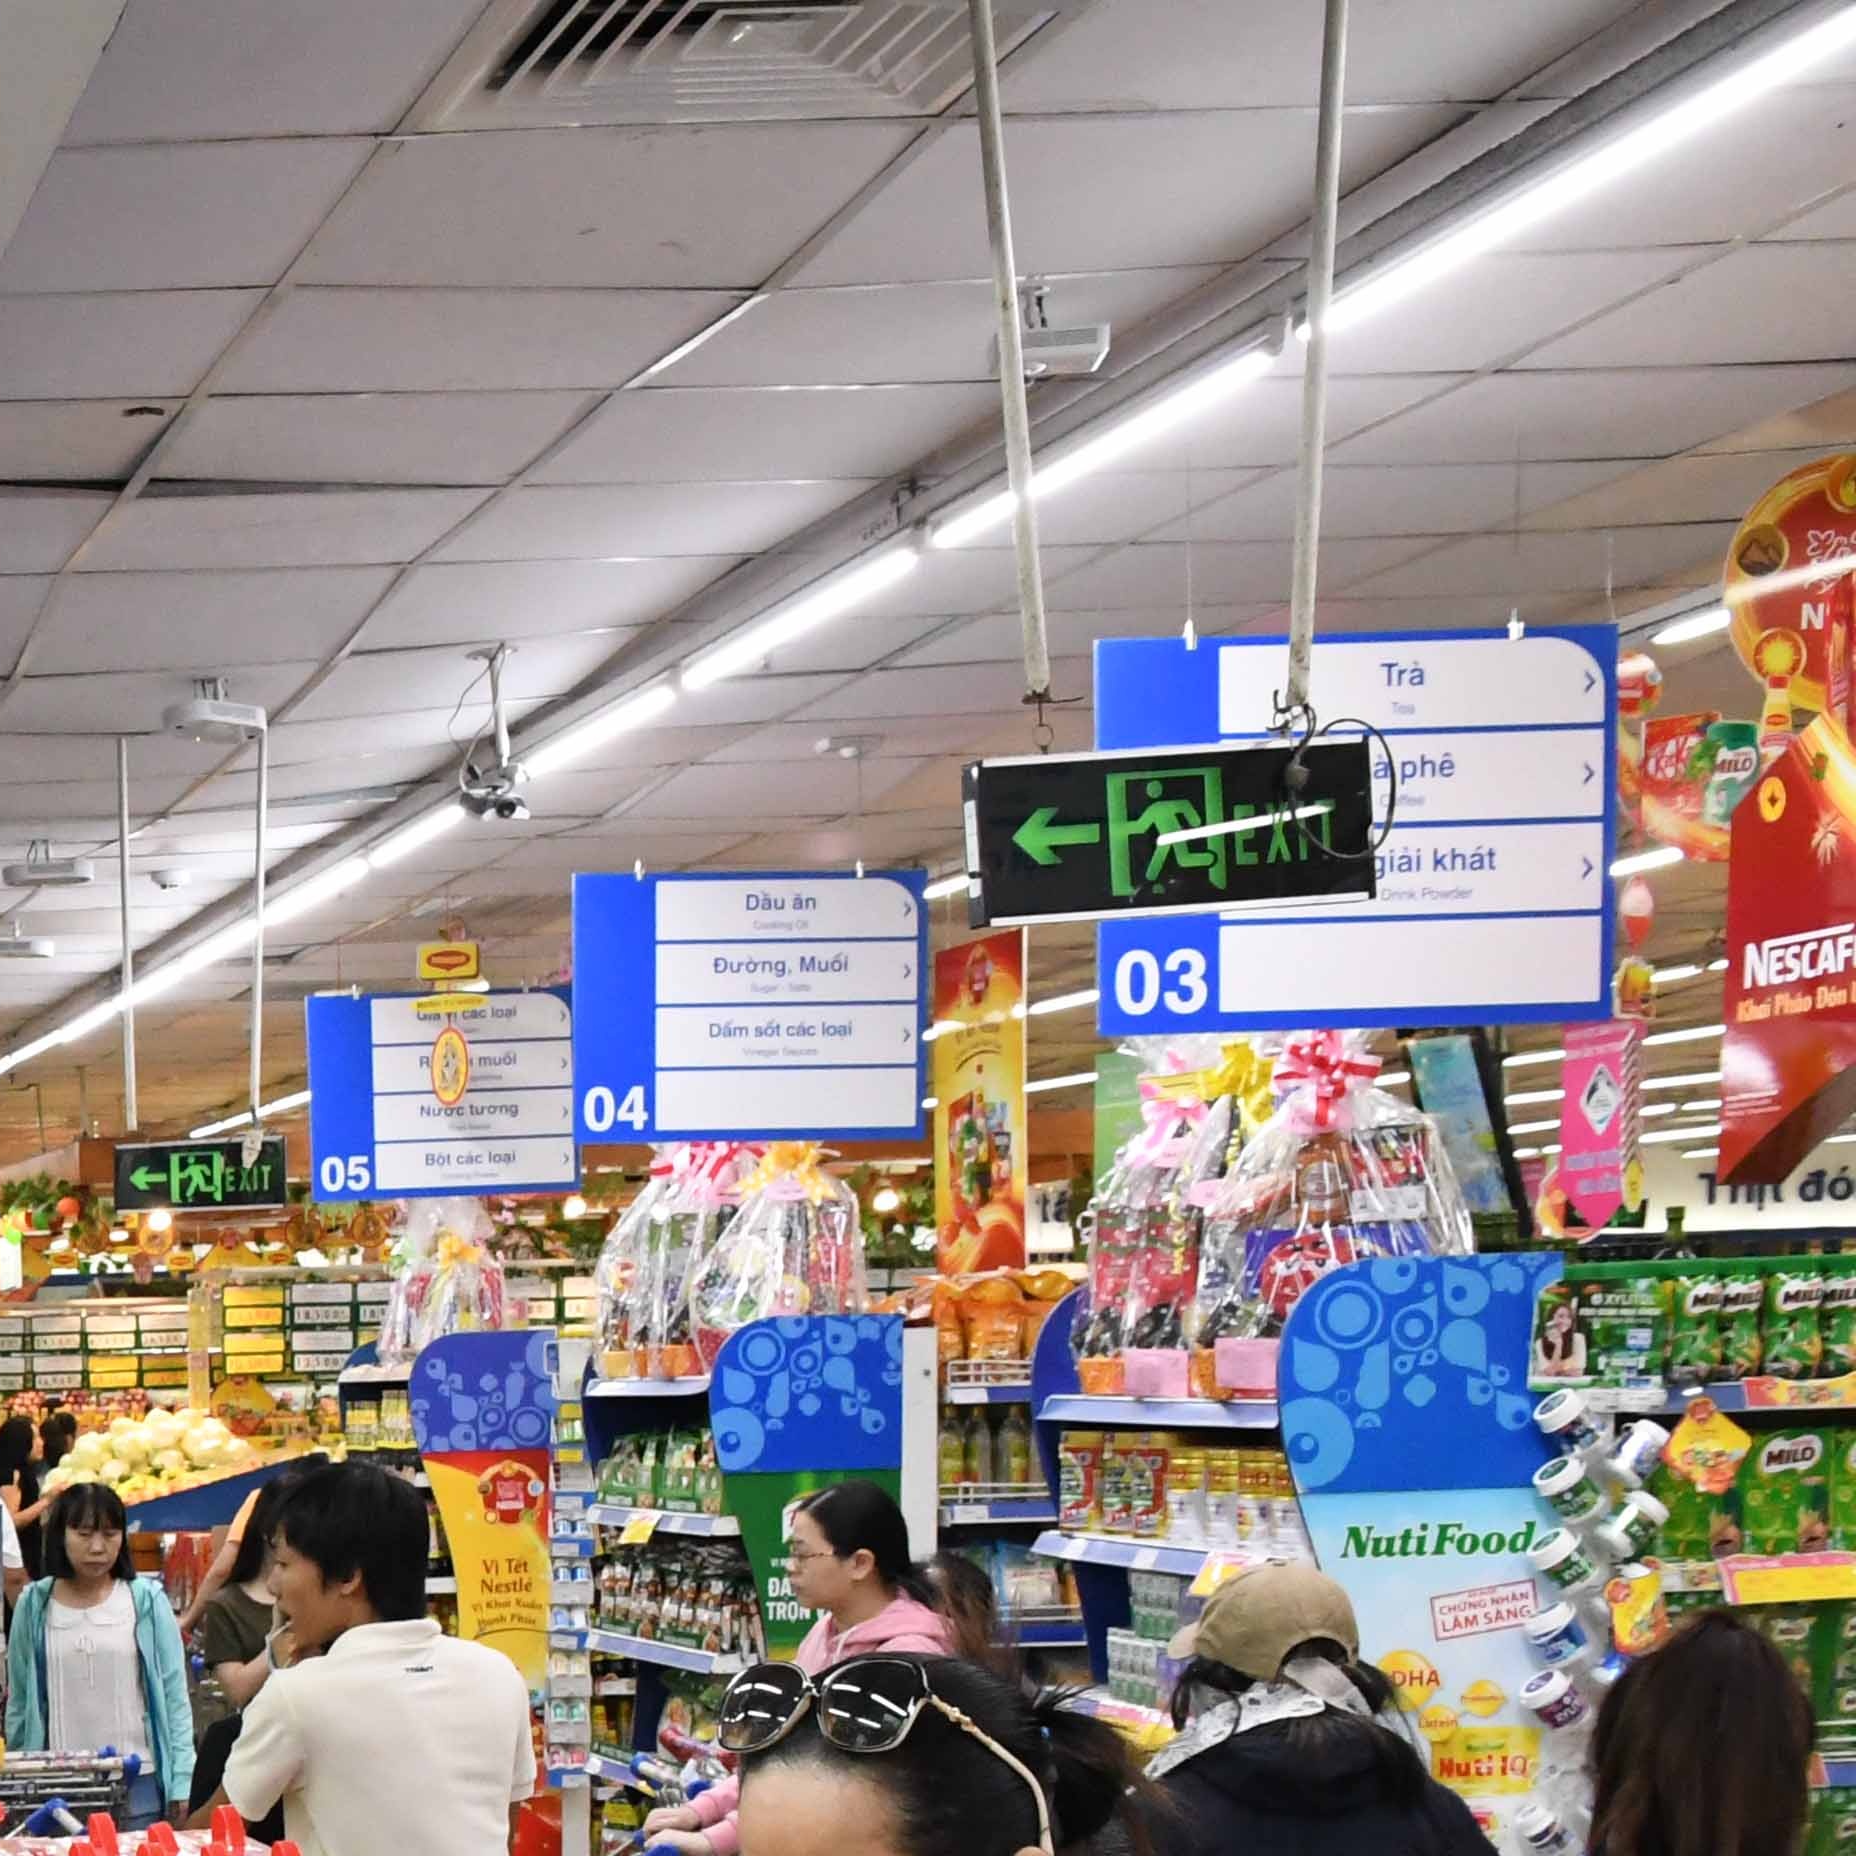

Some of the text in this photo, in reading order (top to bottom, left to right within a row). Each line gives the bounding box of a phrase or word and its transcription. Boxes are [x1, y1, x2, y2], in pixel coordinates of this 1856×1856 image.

[1400, 752, 1456, 787] phê
[1236, 800, 1335, 865] EXIT
[1374, 844, 1497, 877] giải khát
[745, 890, 785, 911] Dầu
[799, 952, 849, 974] Muối
[1743, 923, 1856, 990] NESCAF
[1115, 949, 1208, 1016] 03
[754, 1018, 781, 1037] sốt
[787, 1020, 816, 1037] các
[469, 1103, 519, 1119] tương
[584, 1086, 649, 1133] 04
[456, 1151, 483, 1165] các
[226, 1161, 272, 1194] EXIT
[321, 1156, 371, 1192] 05
[1765, 1444, 1817, 1468] MILO
[481, 1556, 529, 1578] Vị Tết
[480, 1574, 533, 1595] Nestlé
[765, 1601, 808, 1624] TRỌN
[1390, 1669, 1441, 1688] DHA
[1438, 1755, 1530, 1779] Nuti IQ
